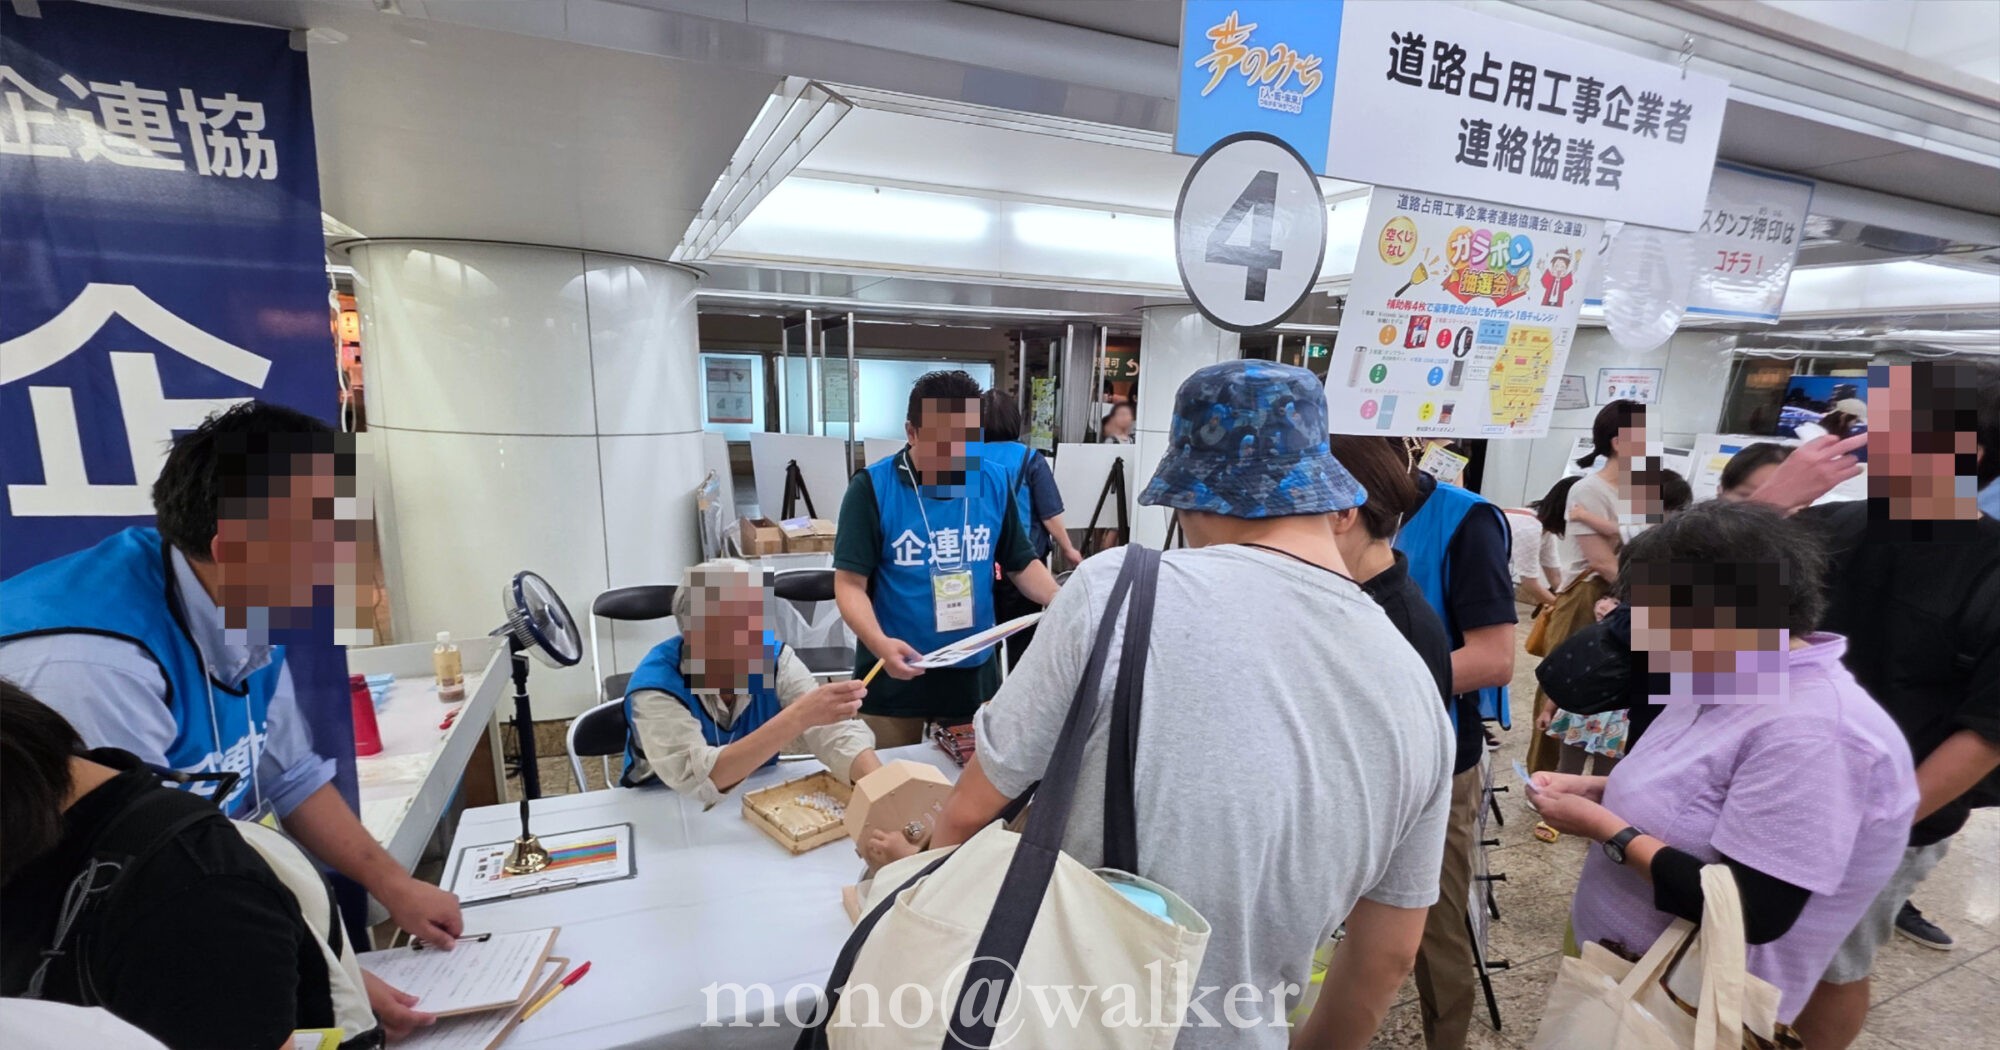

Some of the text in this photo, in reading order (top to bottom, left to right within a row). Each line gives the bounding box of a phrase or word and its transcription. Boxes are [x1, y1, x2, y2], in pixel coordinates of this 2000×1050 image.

[1195, 10, 1323, 97] 夢のみち
[1386, 31, 1693, 145] 道路占用工事企業者
[1455, 118, 1625, 191] 連絡協議会
[1205, 170, 1283, 301] 4
[1384, 227, 1414, 243] 空くじ
[1700, 209, 1796, 244] スタンプ押印は
[1386, 243, 1407, 257] なし
[1451, 232, 1531, 269] ガラポン
[1714, 250, 1764, 275] コチラ！
[1459, 268, 1511, 297] 抽選会
[891, 524, 991, 567] 企連協
